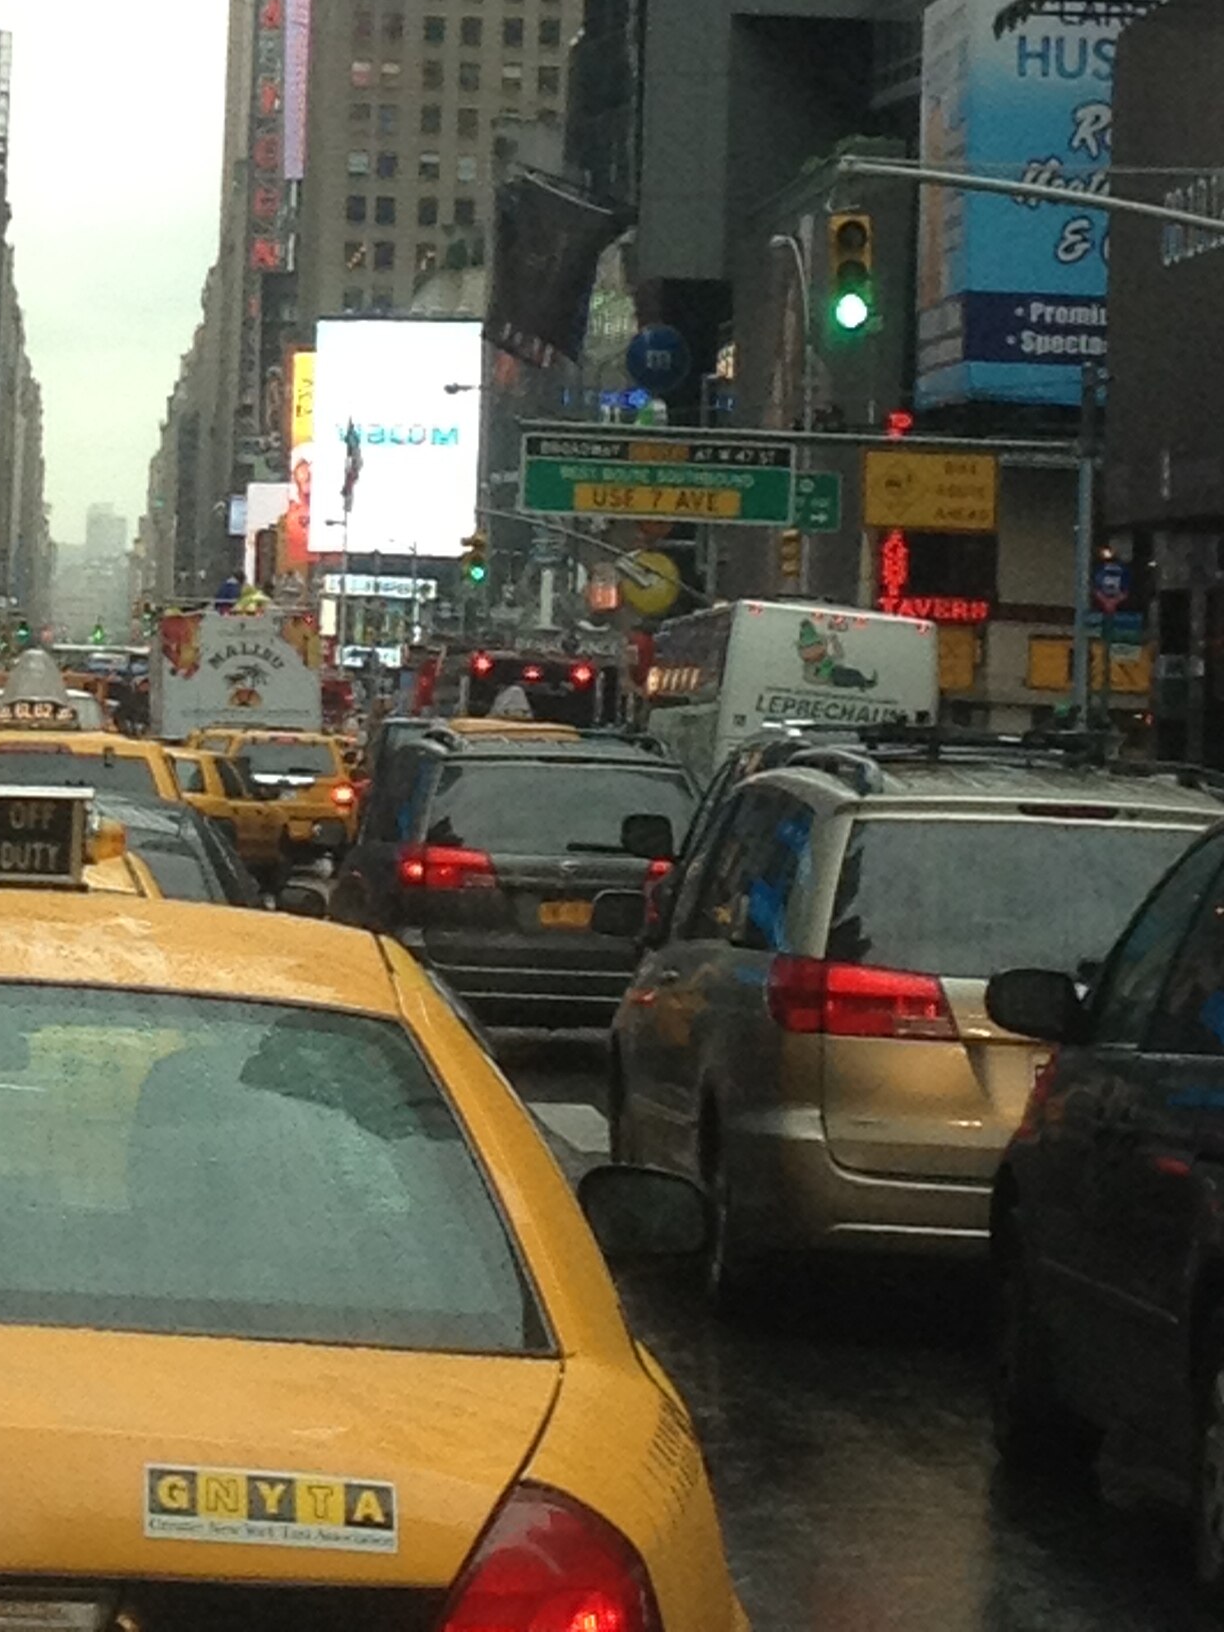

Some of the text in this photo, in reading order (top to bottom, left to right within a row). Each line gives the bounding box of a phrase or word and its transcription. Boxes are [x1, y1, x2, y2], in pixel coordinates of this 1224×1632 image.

[1055, 219, 1095, 264] &
[540, 440, 621, 457] BROADWAY
[592, 488, 721, 512] USE 7 AVE
[878, 595, 990, 620] TAVERN
[208, 642, 286, 670] MALIBU
[9, 801, 57, 830] OFF
[0, 840, 62, 870] DUTY
